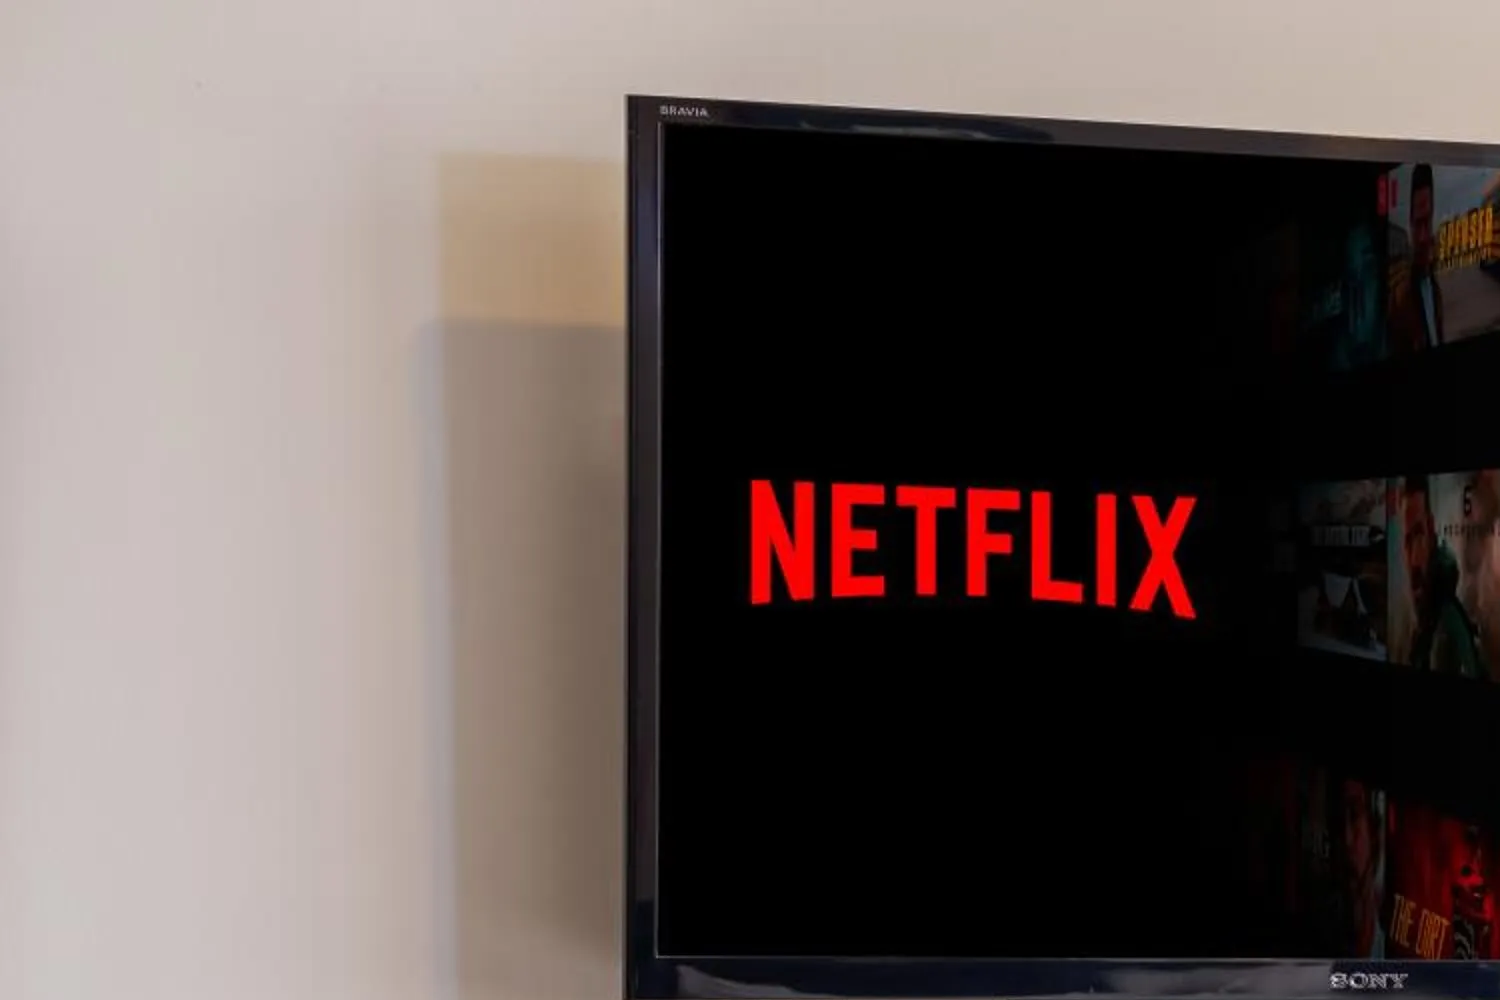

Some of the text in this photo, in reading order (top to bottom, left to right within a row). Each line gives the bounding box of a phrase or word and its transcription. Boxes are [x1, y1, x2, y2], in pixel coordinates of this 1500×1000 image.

[659, 105, 710, 118] BRAVIA
[750, 479, 1198, 620] NETFLIX
[1329, 972, 1410, 990] SONY
